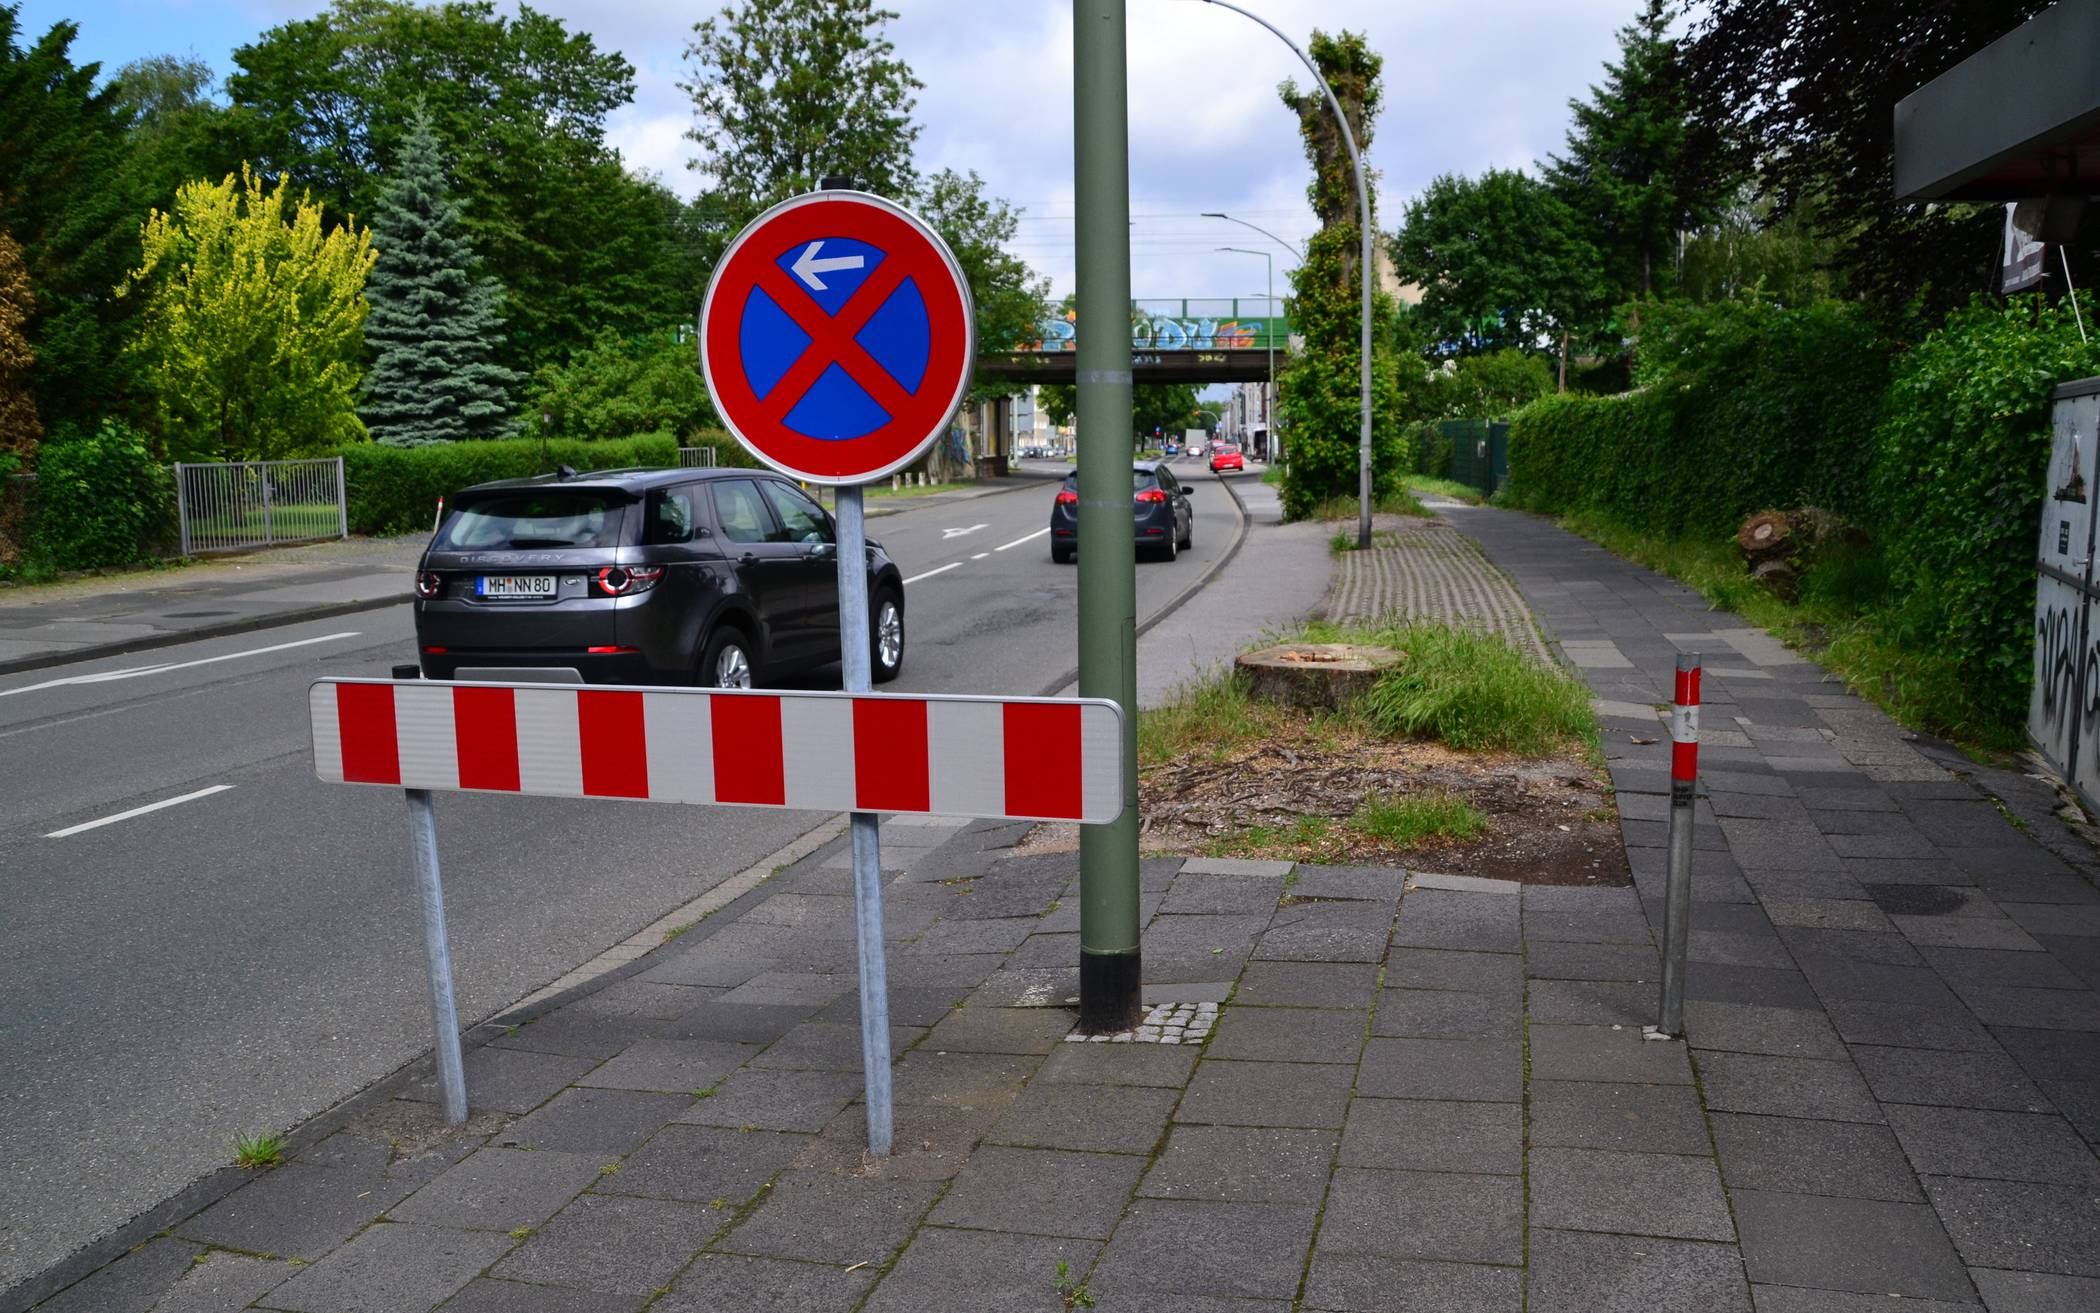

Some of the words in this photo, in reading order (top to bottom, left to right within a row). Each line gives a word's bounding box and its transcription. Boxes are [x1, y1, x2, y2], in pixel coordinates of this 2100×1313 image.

[460, 553, 565, 564] DISCOVERY
[489, 577, 506, 593] MH
[514, 577, 532, 593] NN
[533, 577, 551, 593] 80
